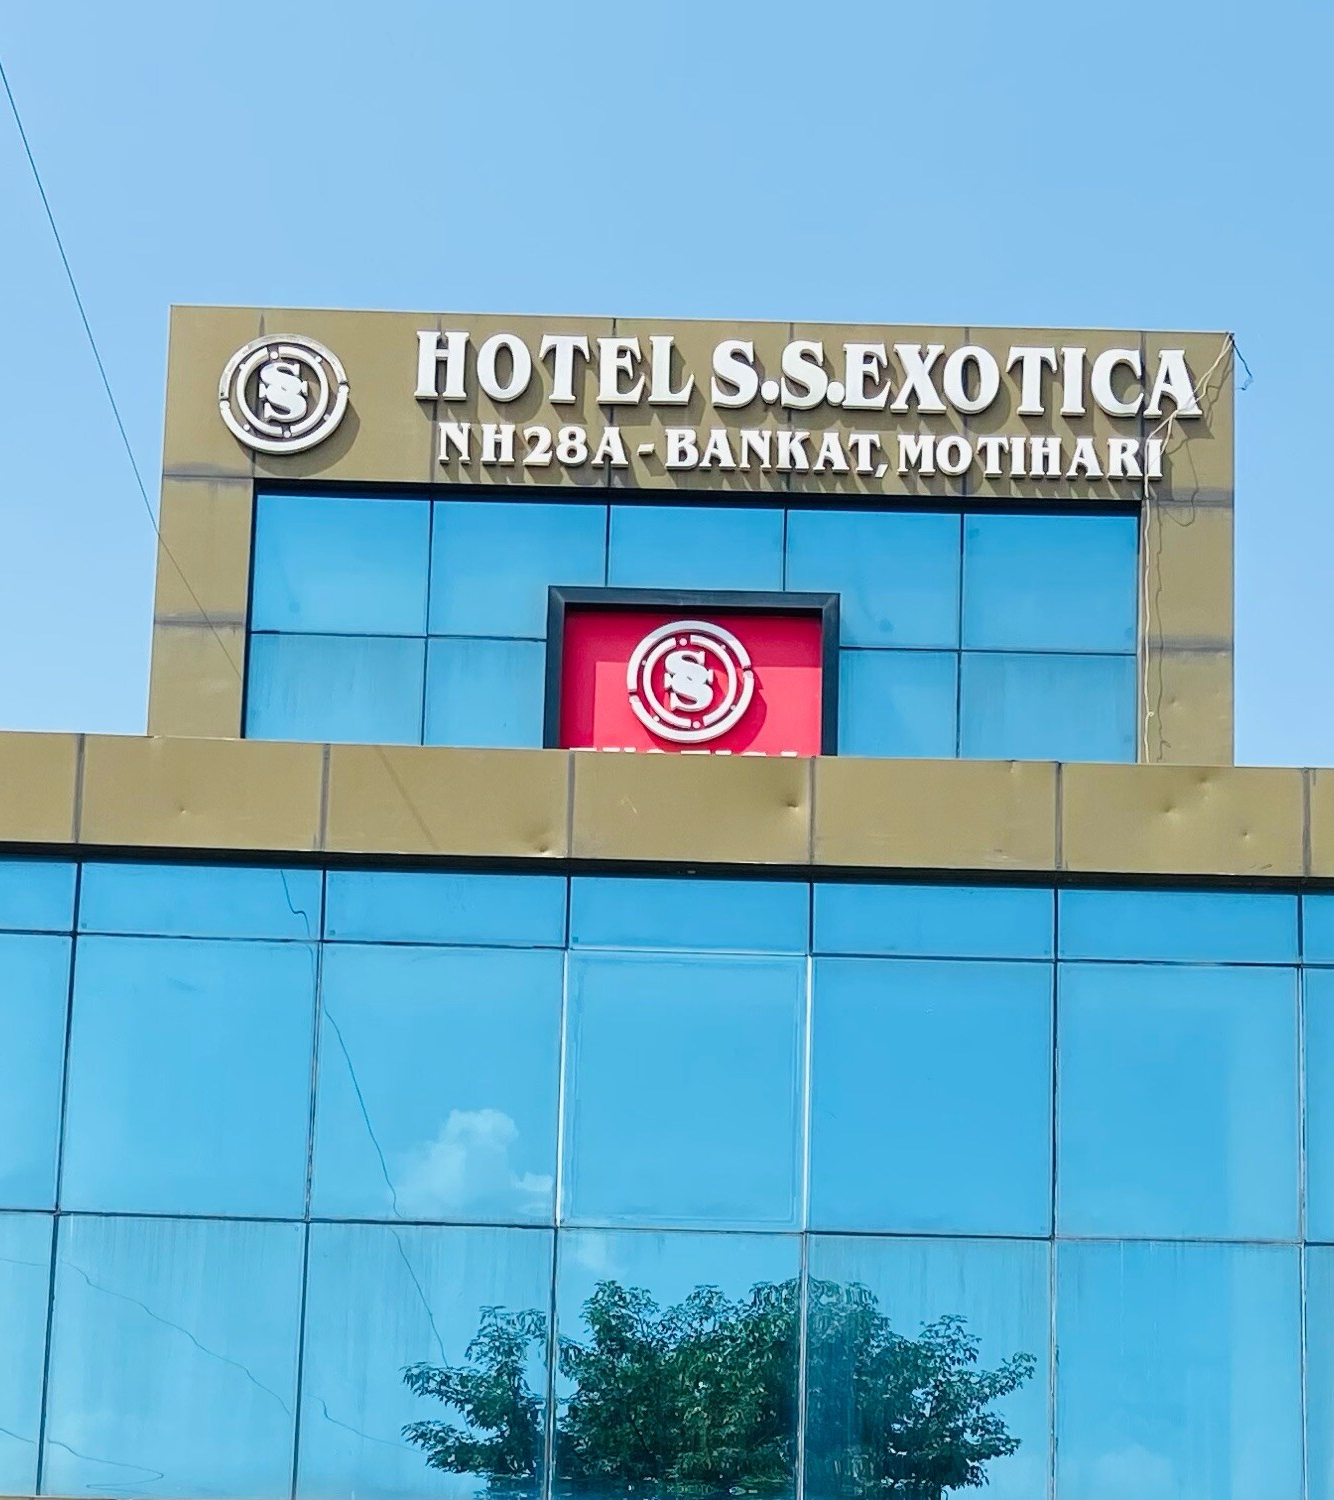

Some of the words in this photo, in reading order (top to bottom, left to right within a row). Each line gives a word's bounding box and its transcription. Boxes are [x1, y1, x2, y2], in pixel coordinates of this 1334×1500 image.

[414, 330, 695, 406] HOTEL
[711, 338, 1204, 420] S.S.EXOTICA
[897, 434, 1164, 482] MOTIHARI
